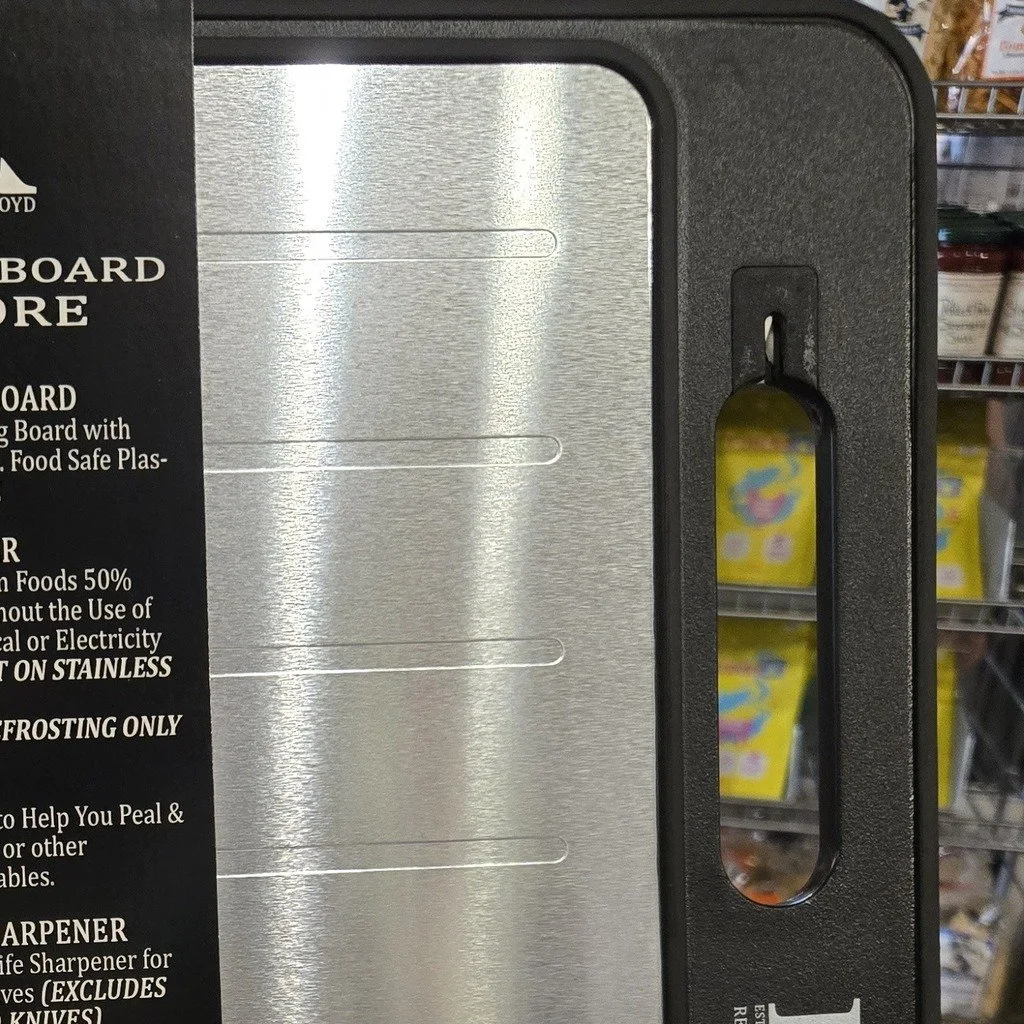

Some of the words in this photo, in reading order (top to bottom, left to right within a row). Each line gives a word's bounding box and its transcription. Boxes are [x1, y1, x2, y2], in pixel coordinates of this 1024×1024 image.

[14, 417, 78, 442] Board
[82, 416, 131, 441] with
[10, 447, 63, 472] Food
[67, 447, 112, 471] Safe
[117, 446, 168, 470] Plas-
[15, 568, 78, 593] Foods
[84, 567, 132, 592] 50%
[48, 598, 83, 622] the
[87, 598, 126, 621] Use
[131, 595, 154, 619] of
[26, 634, 50, 652] or
[55, 627, 163, 655] Electricity
[13, 659, 48, 682] ON
[51, 655, 173, 681] STAINLESS
[122, 714, 184, 738] ONLY
[21, 805, 70, 834] Help
[74, 805, 114, 827] You
[119, 801, 162, 826] Peal
[2, 842, 26, 859] or
[31, 834, 88, 858] other
[29, 951, 138, 978] Sharpener
[142, 947, 173, 970] for
[41, 976, 168, 1008] (EXCLUDES
